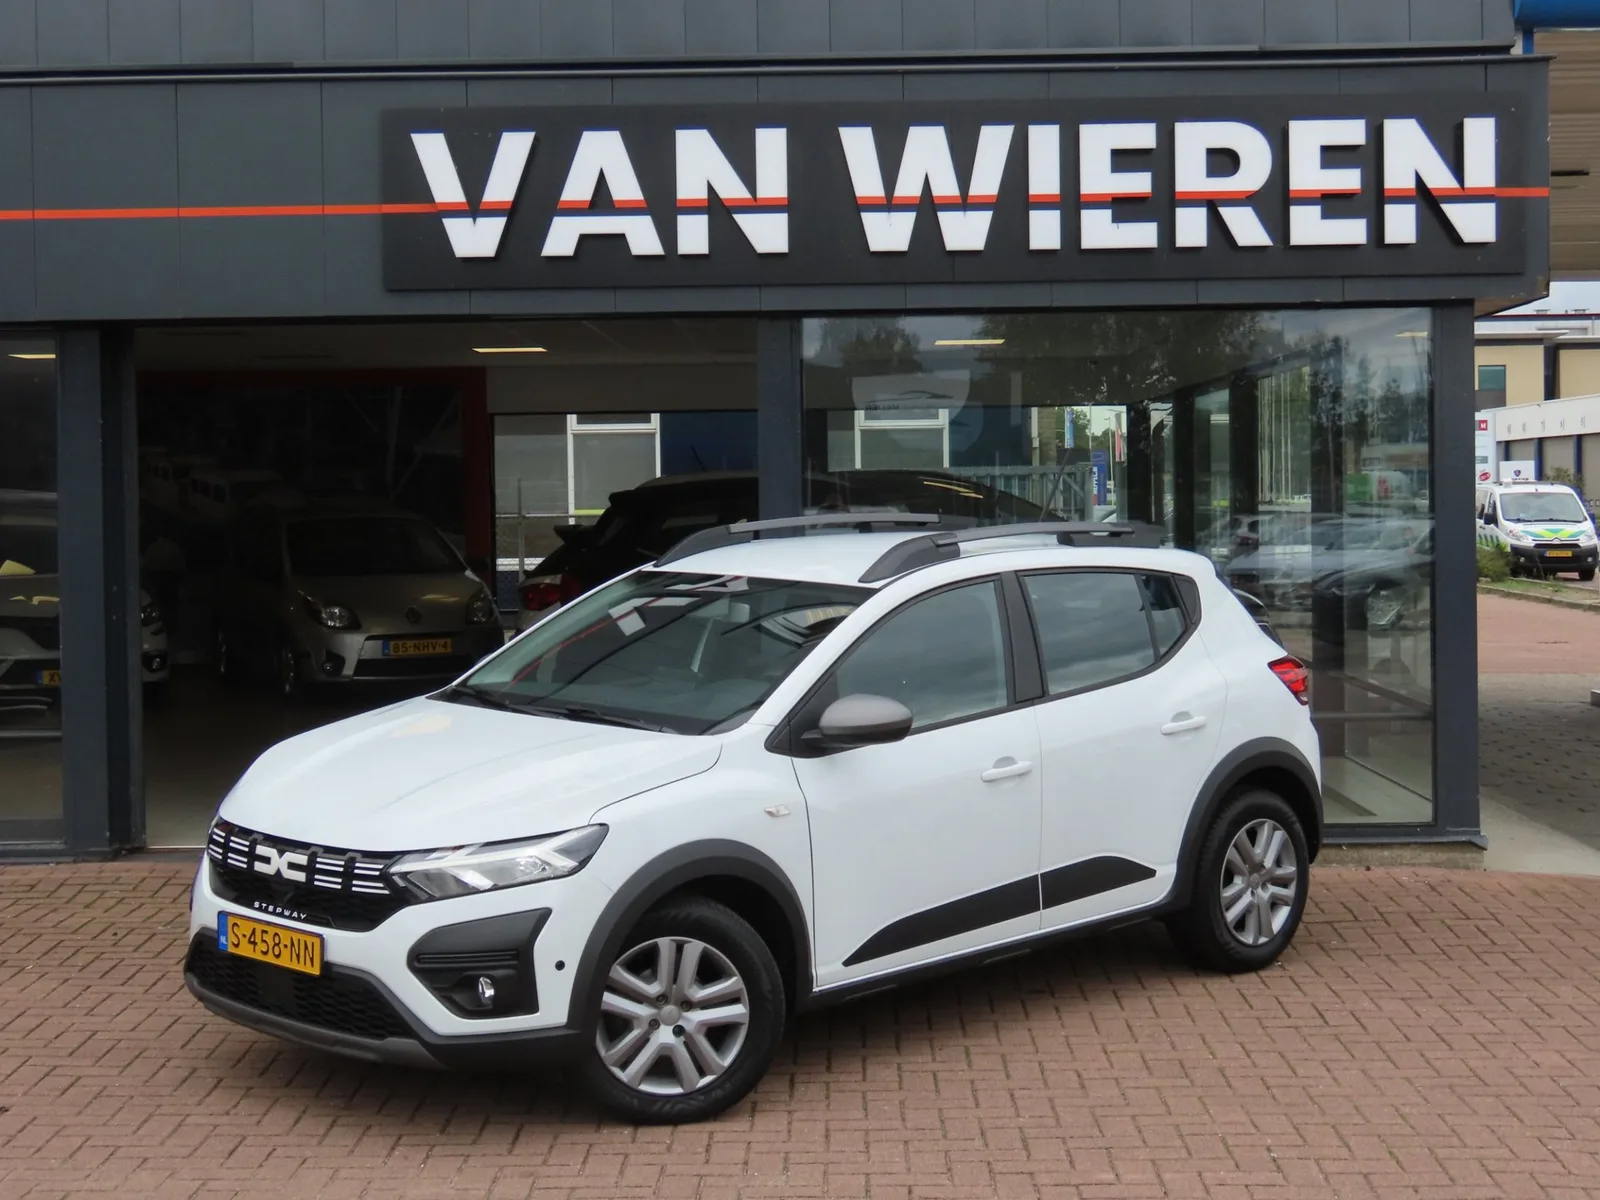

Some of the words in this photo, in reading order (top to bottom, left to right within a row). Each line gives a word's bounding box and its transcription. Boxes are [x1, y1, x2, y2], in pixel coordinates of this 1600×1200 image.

[410, 127, 790, 259] VAN
[838, 117, 1498, 253] WIEREN
[391, 640, 449, 654] 85-NHV-4
[253, 901, 308, 920] STEPWAY
[230, 921, 316, 968] S-458-NN
